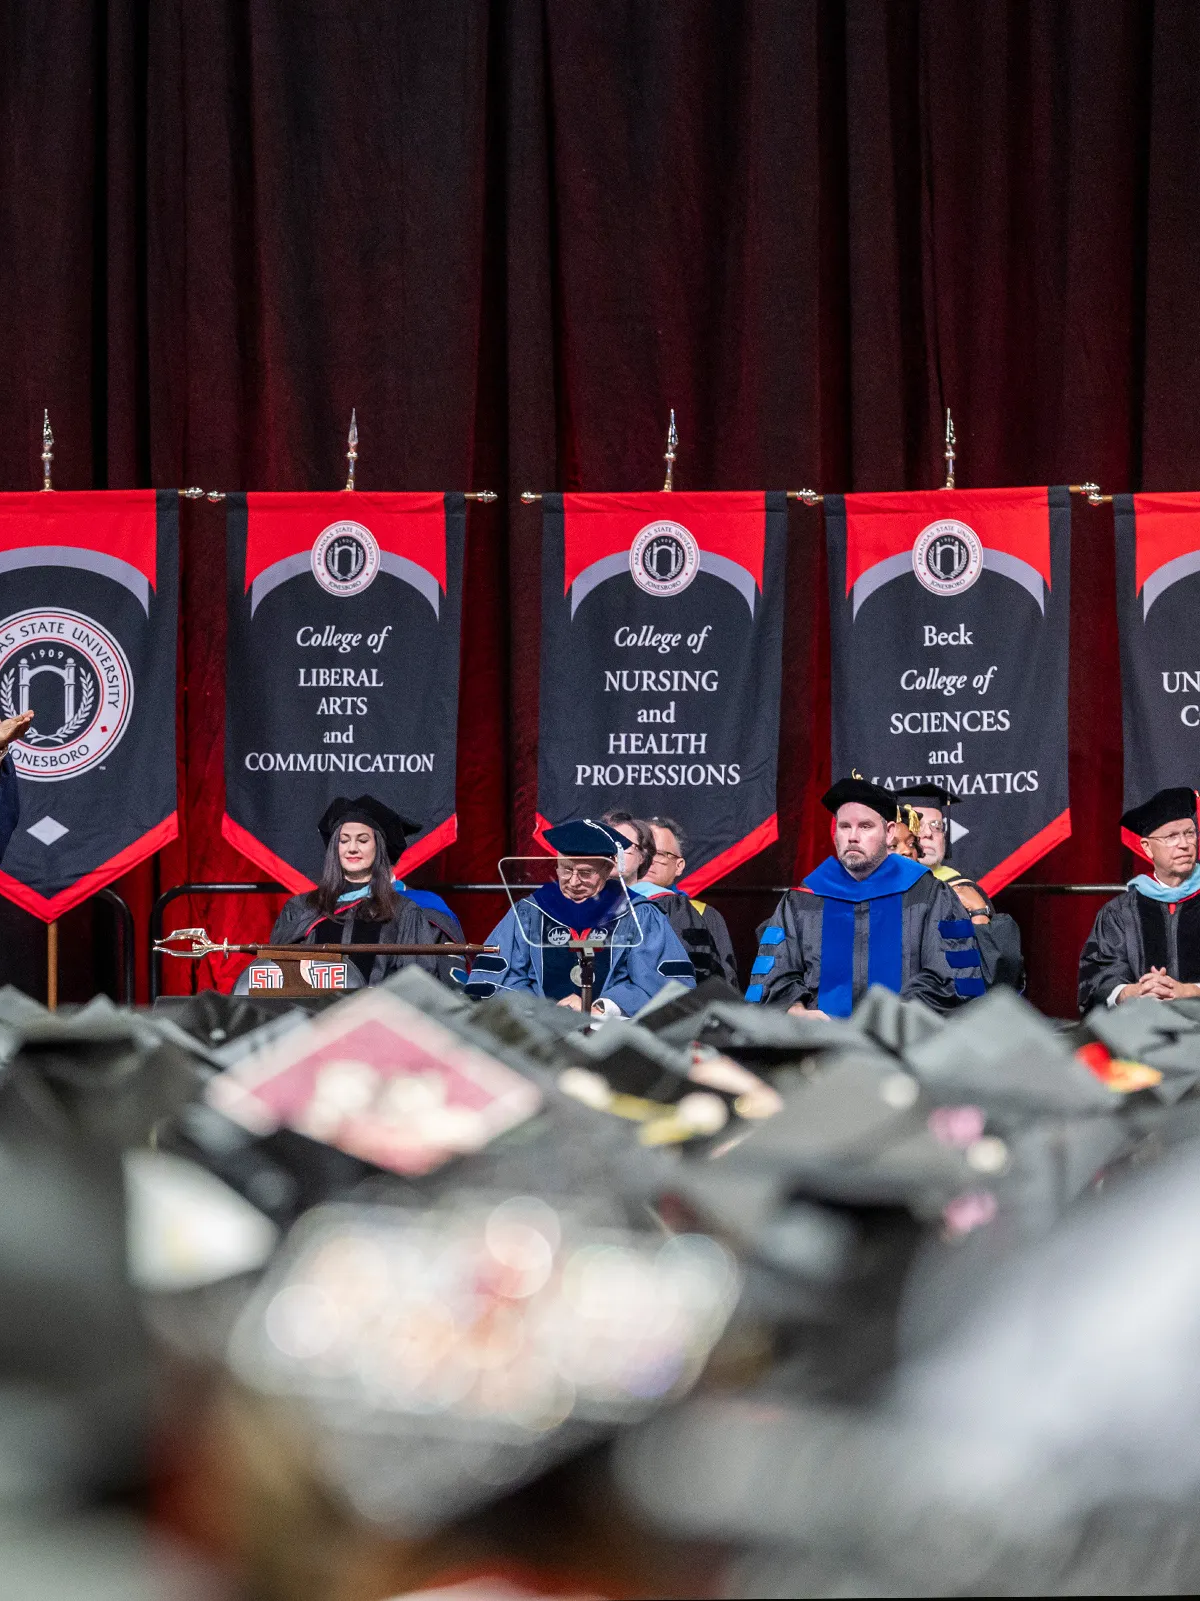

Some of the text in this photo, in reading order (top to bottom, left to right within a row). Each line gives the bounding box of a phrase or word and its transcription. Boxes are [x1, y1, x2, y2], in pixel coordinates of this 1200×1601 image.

[297, 626, 392, 653] College of
[615, 625, 712, 653] College of
[924, 624, 973, 646] Beck
[20, 621, 65, 637] STATE
[72, 627, 120, 709] UNIVERSITY
[30, 649, 64, 660] 1909
[299, 669, 383, 686] LIBERAL
[606, 670, 718, 691] NURSING
[901, 666, 997, 696] College of
[317, 697, 367, 715] ARTS
[638, 702, 675, 723] and
[890, 710, 1010, 734] SCIENCES
[324, 725, 353, 743] and
[609, 734, 706, 754] HEALTH
[9, 744, 89, 767] ONESBORO
[246, 754, 434, 772] COMMUNICATION
[929, 742, 963, 764] and
[576, 764, 740, 785] PROFESSIONS
[251, 966, 346, 988] STTE
